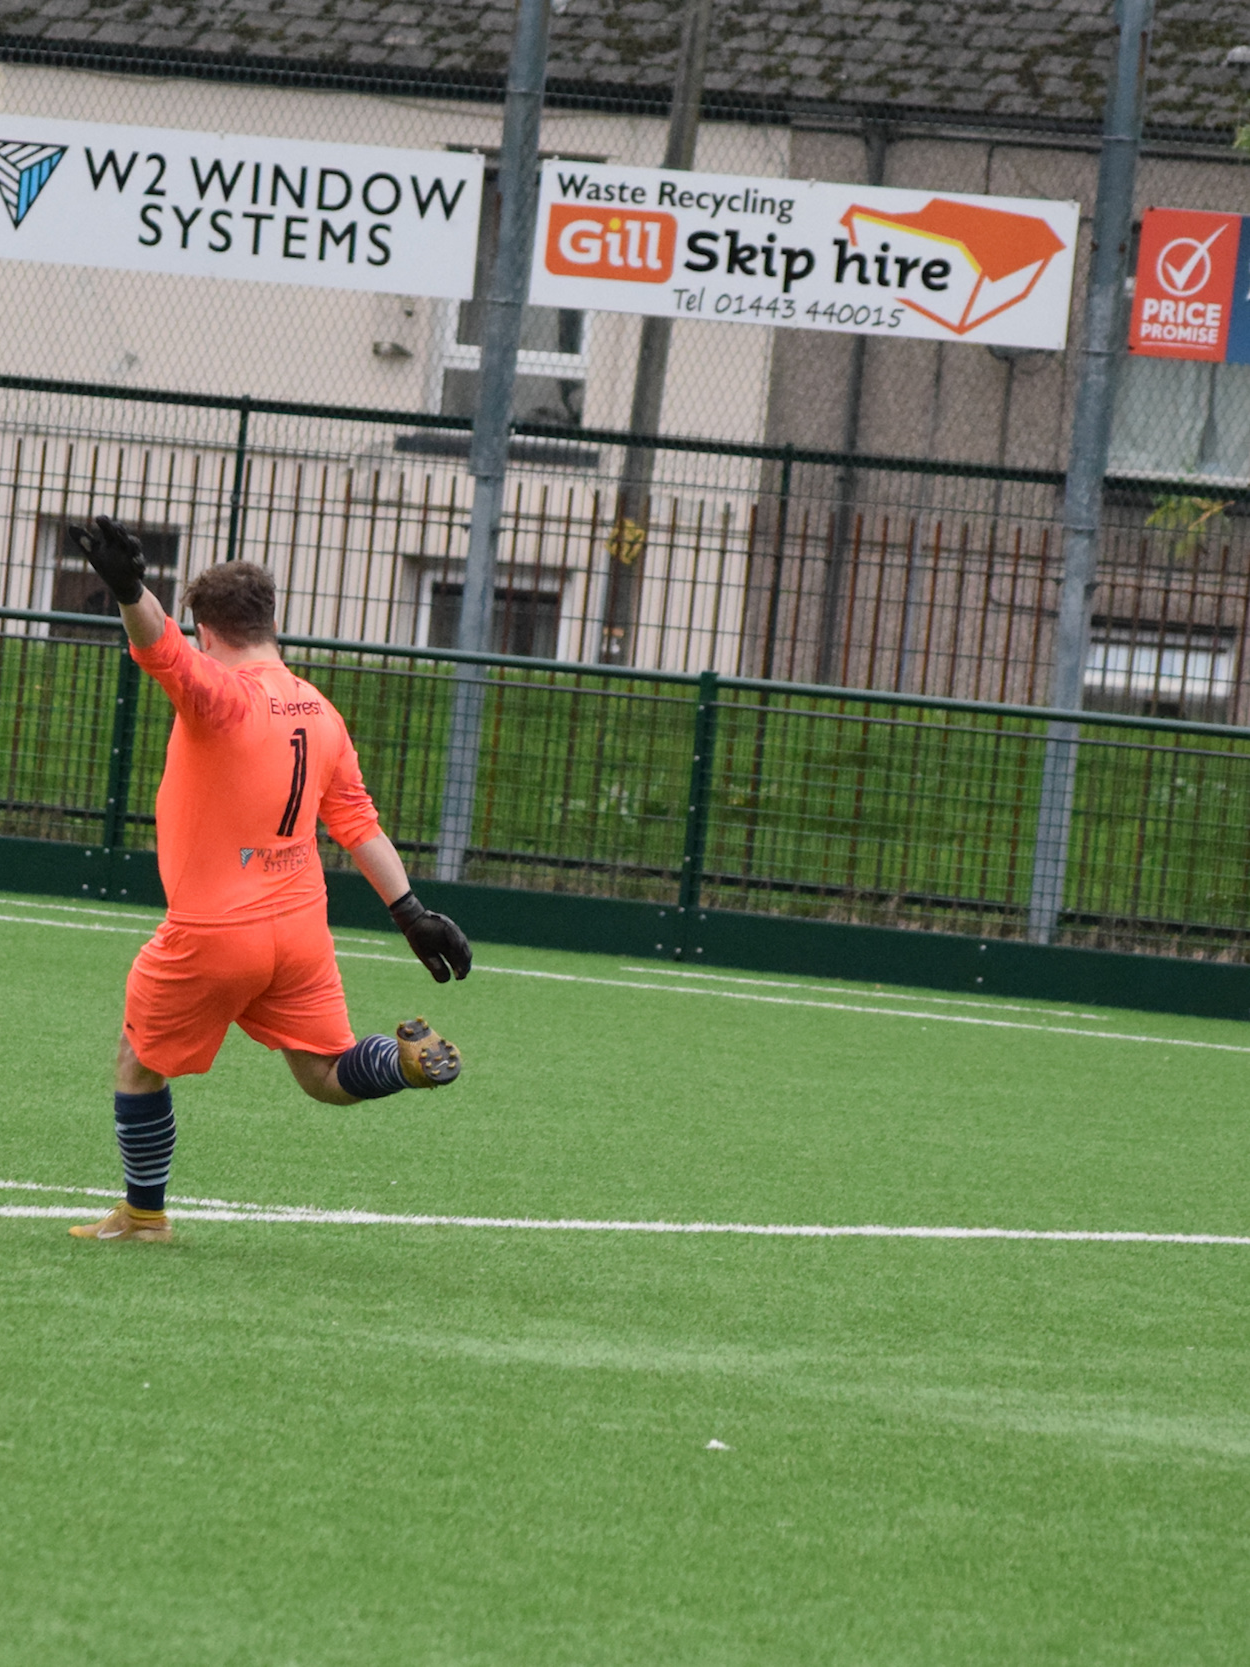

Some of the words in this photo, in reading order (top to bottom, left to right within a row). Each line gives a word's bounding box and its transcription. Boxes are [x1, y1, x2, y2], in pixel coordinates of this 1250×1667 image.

[84, 146, 167, 197] W2
[190, 156, 467, 222] WINDOW
[558, 173, 647, 205] Waste
[657, 181, 795, 225] Recycling
[138, 203, 392, 266] SYSTEMS
[558, 217, 663, 270] Gill
[683, 229, 816, 292] Skip
[833, 239, 951, 292] hire
[673, 288, 703, 314] Tel
[715, 293, 797, 321] 01443
[805, 301, 906, 329] 440015
[1140, 322, 1219, 345] PROMISE
[1142, 298, 1222, 327] PRICE
[270, 697, 324, 717] Everest
[276, 728, 307, 837] 1
